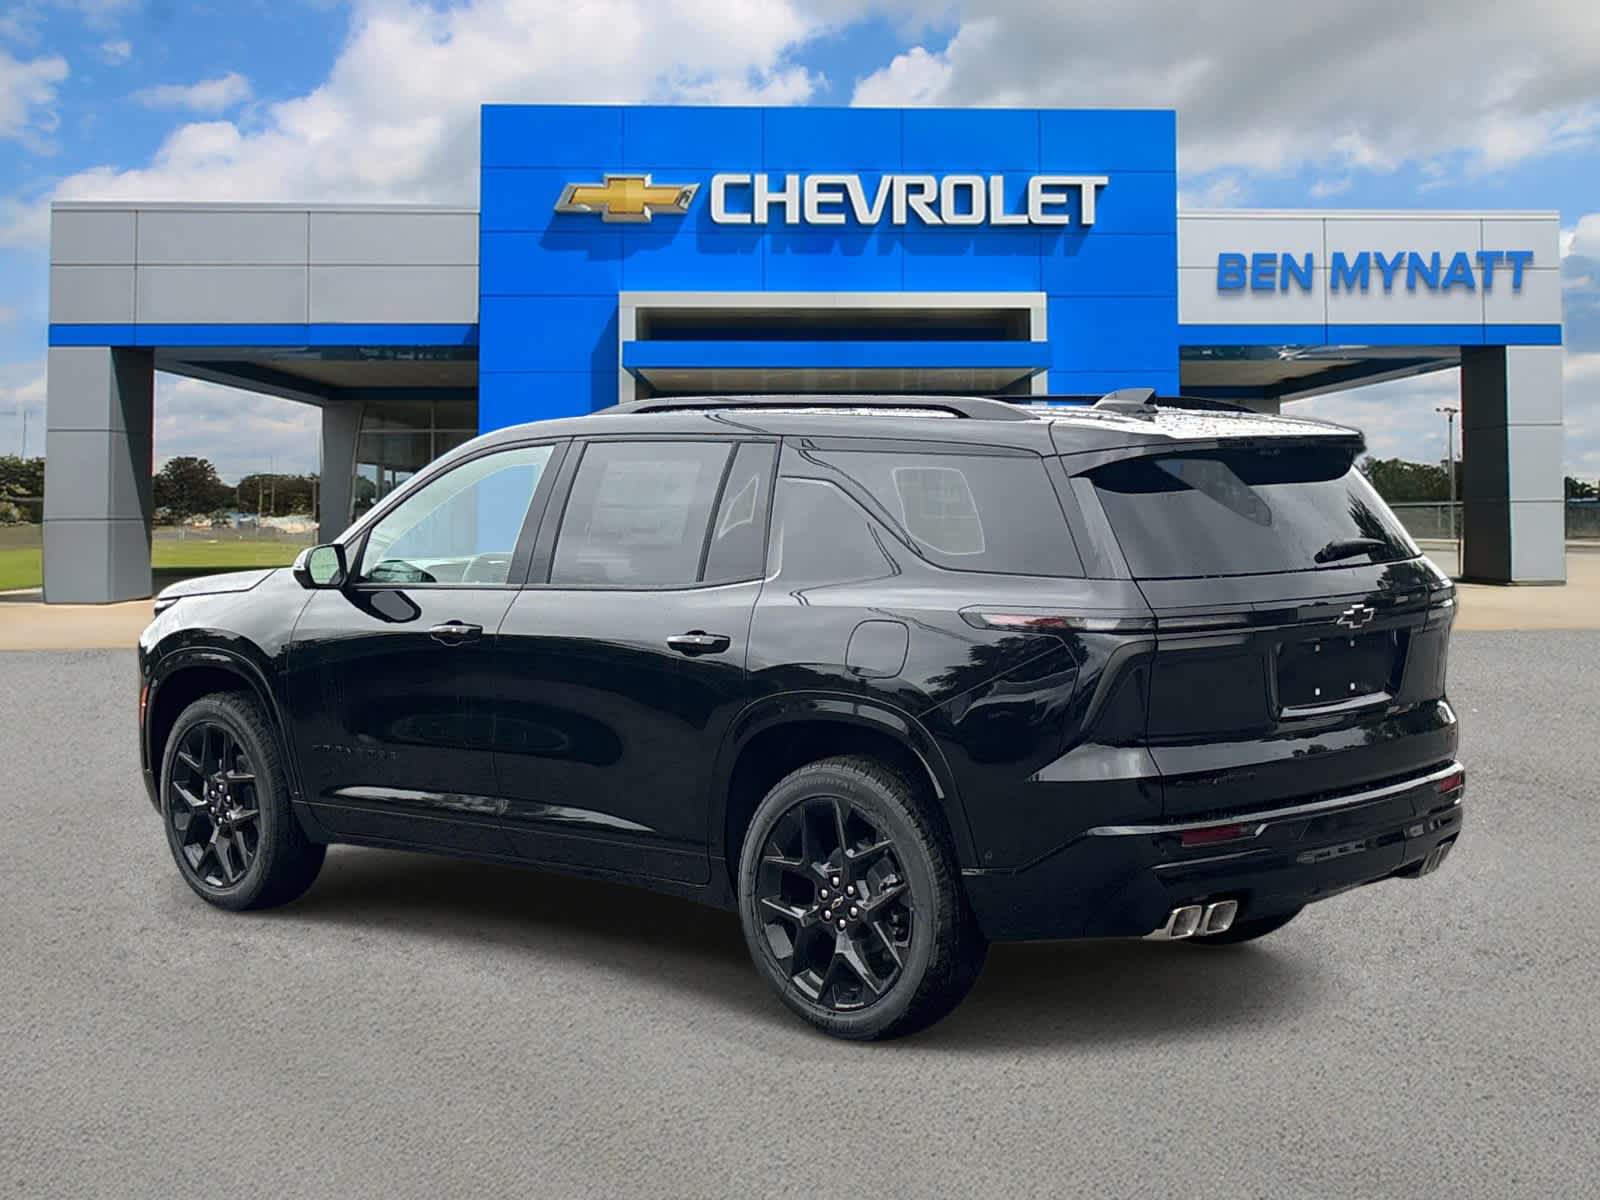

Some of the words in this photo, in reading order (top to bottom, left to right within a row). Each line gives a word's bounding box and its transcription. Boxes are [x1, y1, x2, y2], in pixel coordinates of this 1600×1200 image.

[710, 173, 1109, 225] CHEVROLET
[1217, 252, 1314, 291] BEN
[1330, 250, 1534, 290] MYNATT
